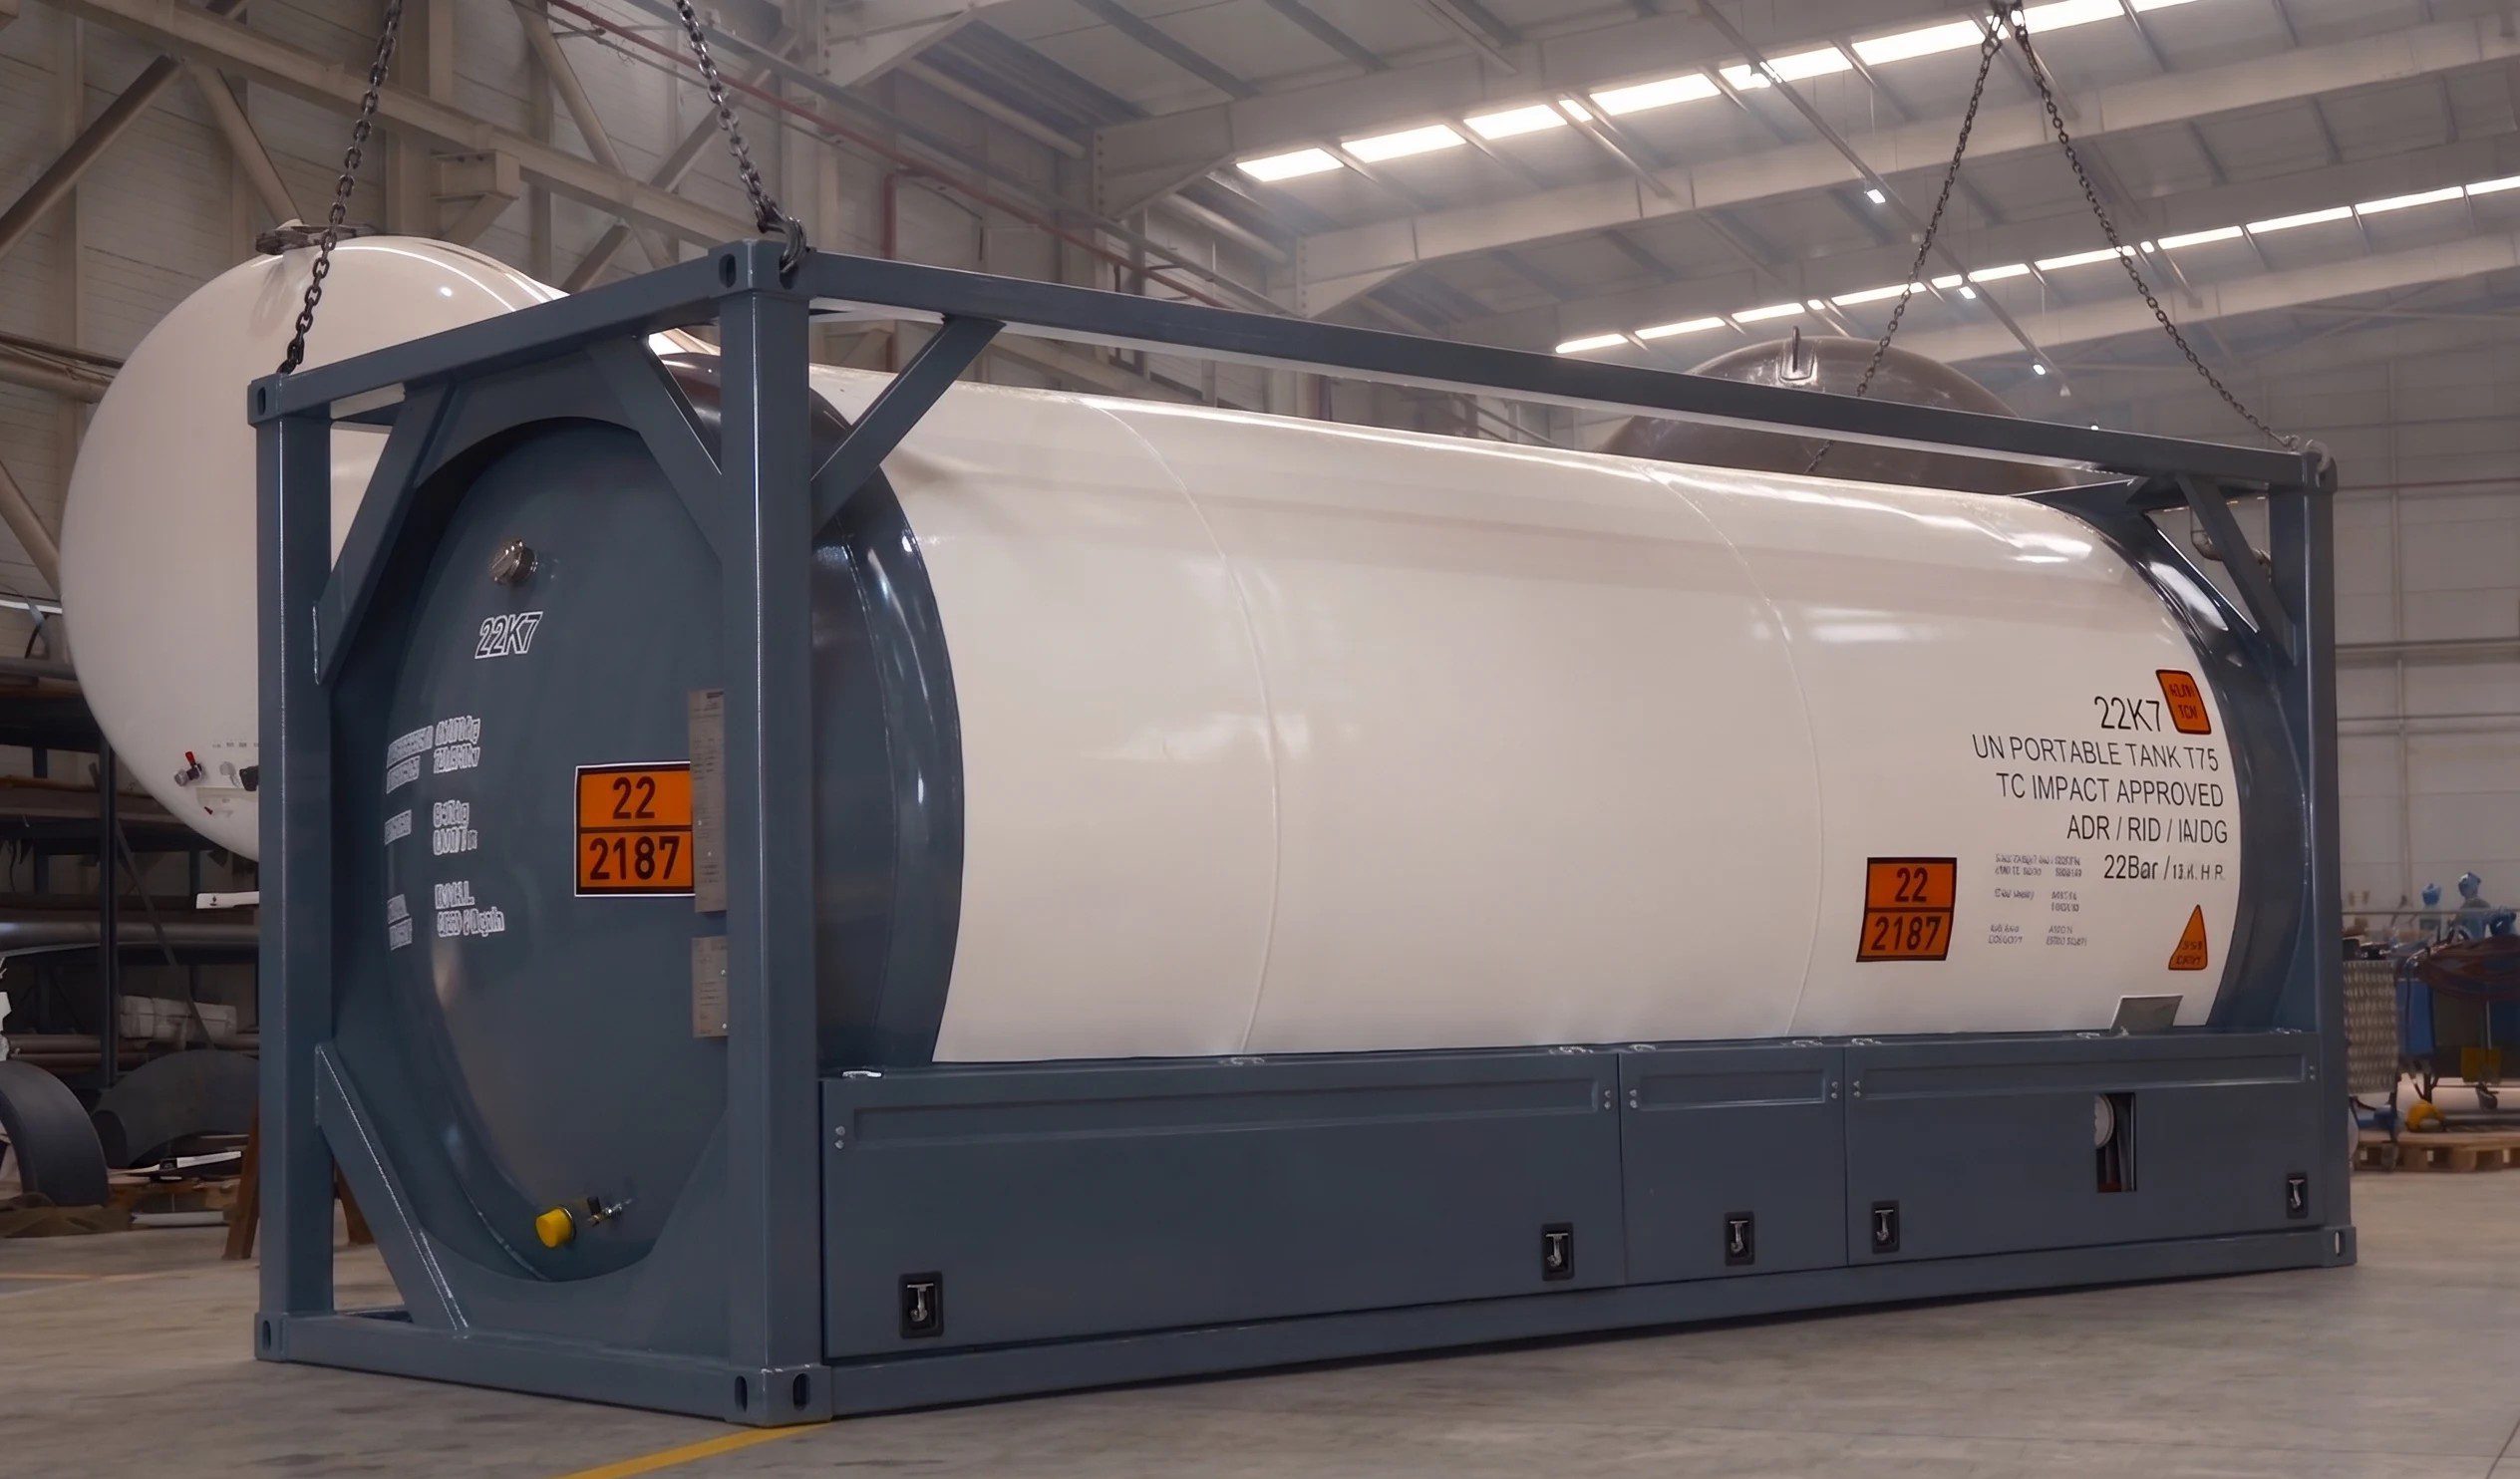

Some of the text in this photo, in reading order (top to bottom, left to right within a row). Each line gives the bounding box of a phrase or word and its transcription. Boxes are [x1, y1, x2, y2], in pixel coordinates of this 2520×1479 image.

[474, 611, 543, 659] 22K7
[2094, 696, 2161, 732] 22K7
[1972, 734, 2219, 771] UN PORTABLE TANK T75
[612, 775, 656, 820] 22
[1996, 772, 2224, 807] TC IMPACT APPROVED
[2066, 814, 2110, 840] ADR
[2128, 816, 2161, 842] RID
[589, 835, 681, 881] 2187
[2103, 854, 2159, 879] 22Bar
[1895, 866, 1929, 903] 22
[1870, 915, 1943, 951] 2187
